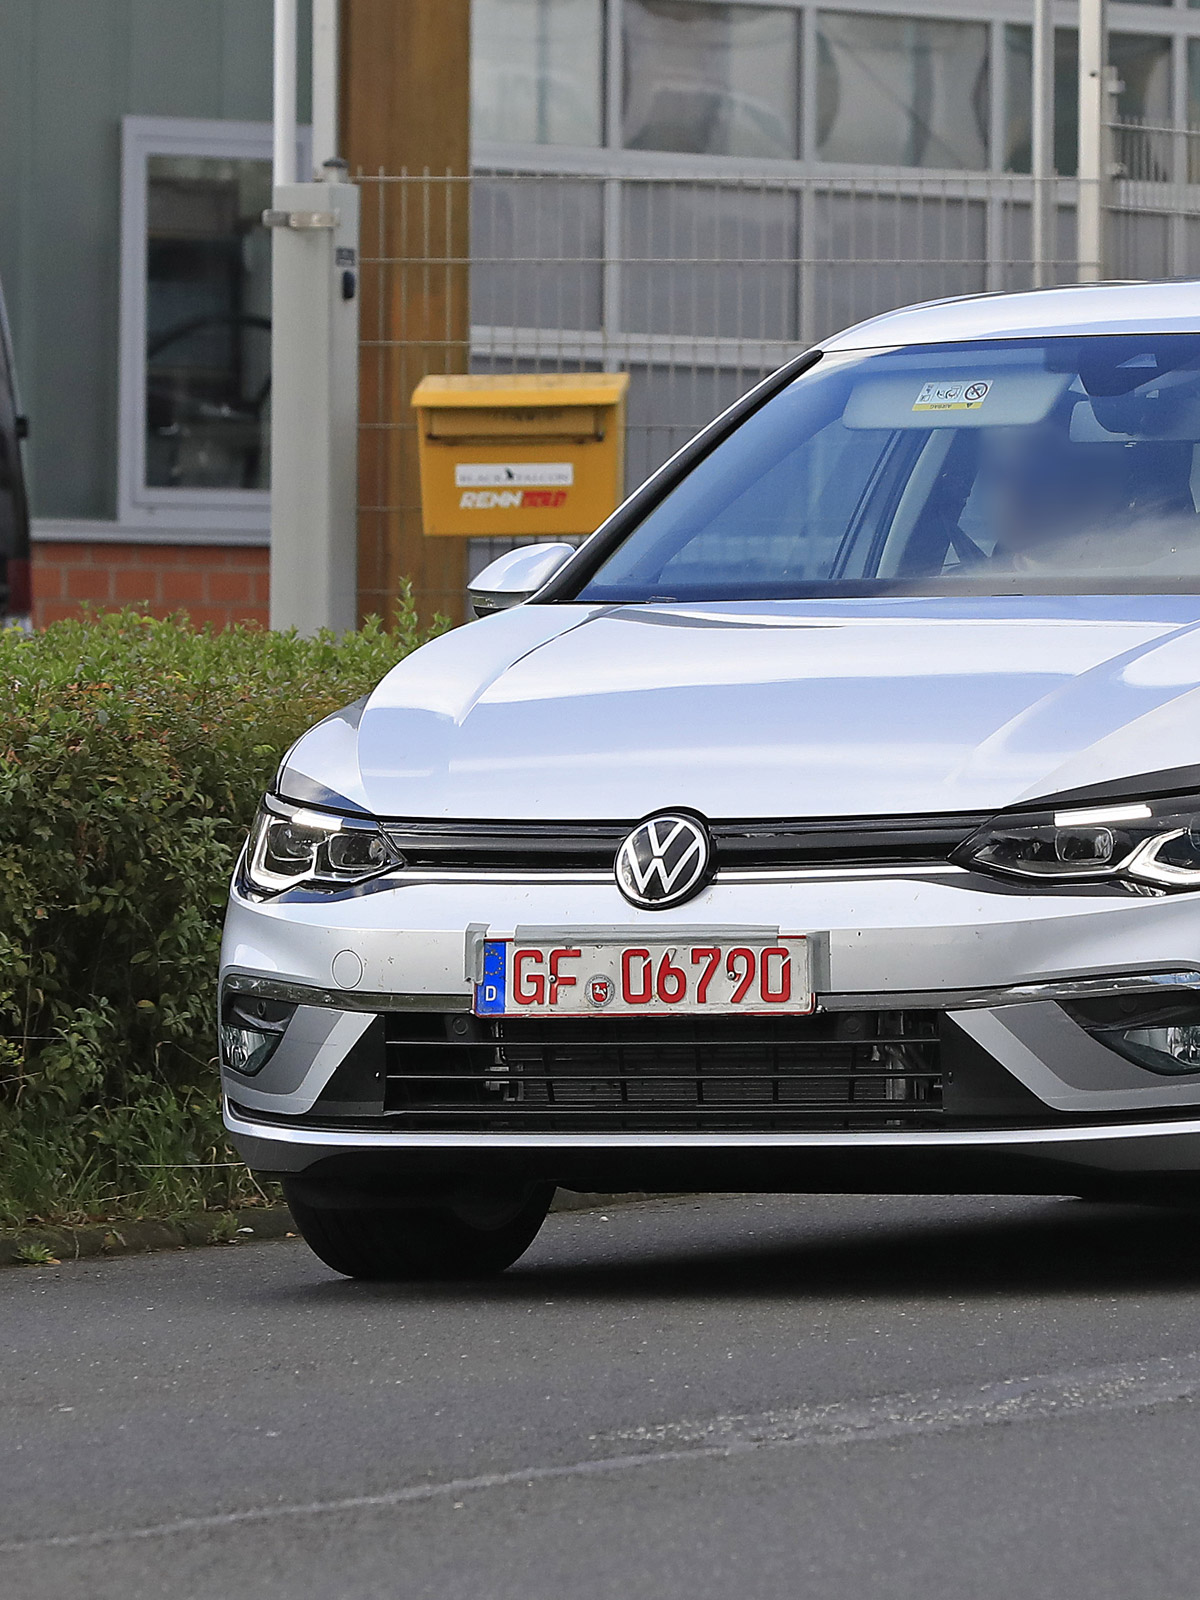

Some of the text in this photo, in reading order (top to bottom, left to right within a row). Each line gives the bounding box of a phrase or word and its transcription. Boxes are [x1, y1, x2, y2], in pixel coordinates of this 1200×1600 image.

[618, 818, 704, 902] VW
[484, 985, 497, 1002] D
[513, 949, 581, 1005] GF
[621, 947, 791, 1004] 06790
